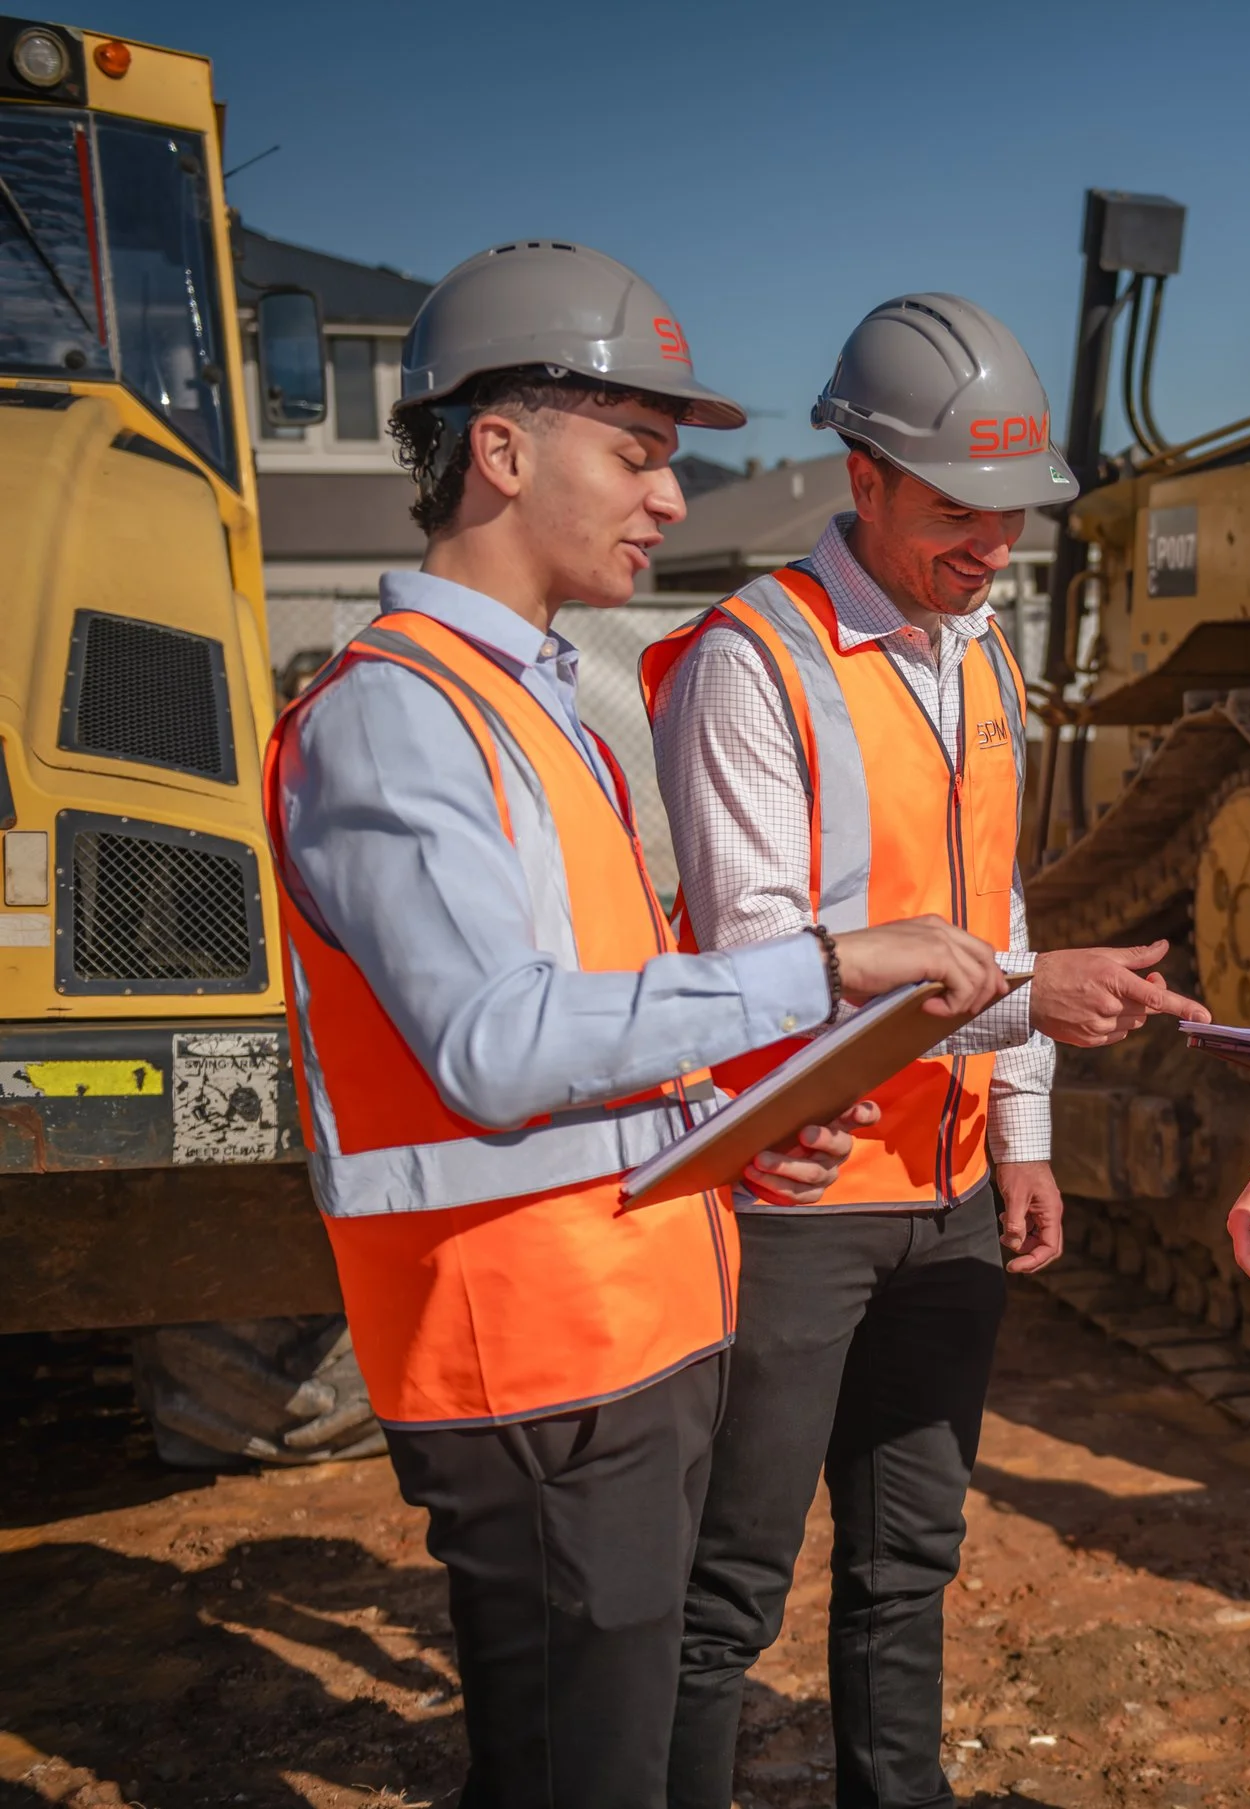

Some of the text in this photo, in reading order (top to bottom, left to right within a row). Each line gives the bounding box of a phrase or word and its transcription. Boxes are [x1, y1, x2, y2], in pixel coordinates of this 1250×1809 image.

[968, 411, 1049, 452] SPM
[1156, 533, 1195, 570] P007
[977, 717, 1007, 744] SPM
